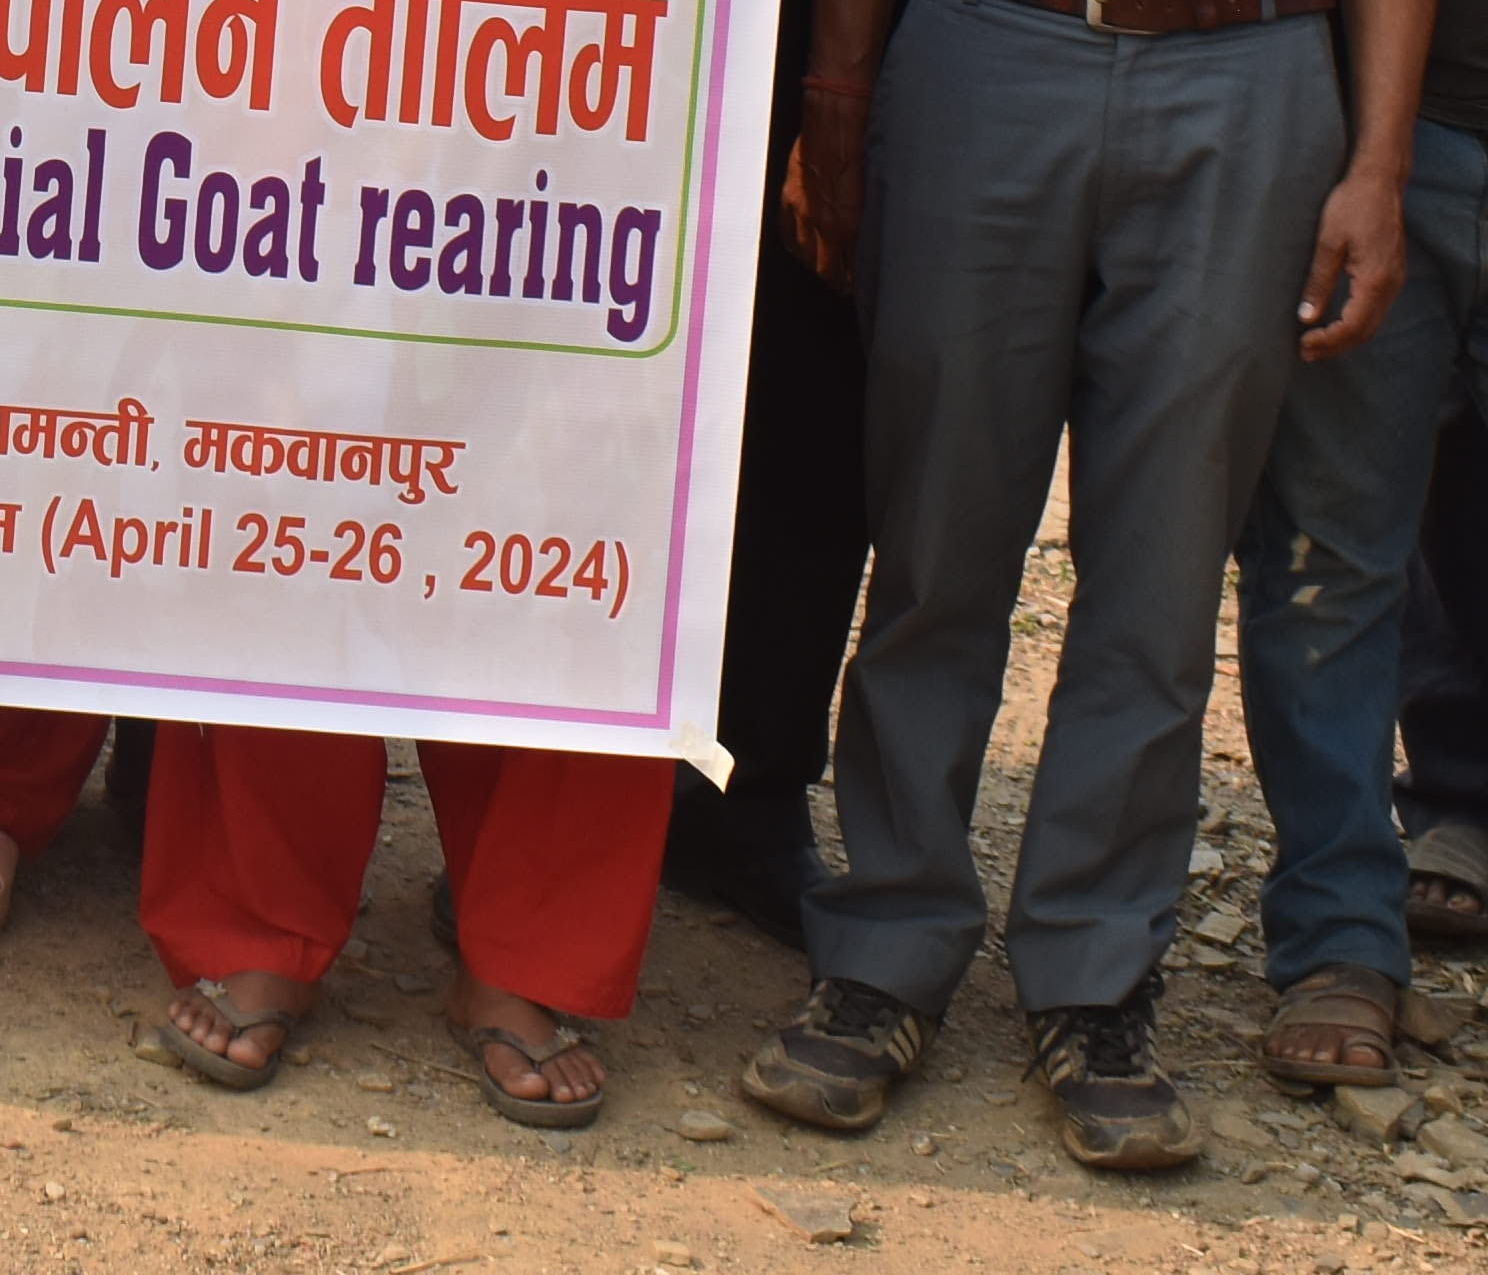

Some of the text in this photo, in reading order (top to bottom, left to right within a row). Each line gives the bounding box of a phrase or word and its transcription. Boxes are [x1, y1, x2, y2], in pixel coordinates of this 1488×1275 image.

[138, 131, 325, 282] Goat
[354, 169, 661, 342] rearing
[184, 419, 466, 504] मकवानपुर
[41, 495, 212, 578] (April
[232, 512, 402, 584] 25-26
[459, 530, 630, 619] 2024)
